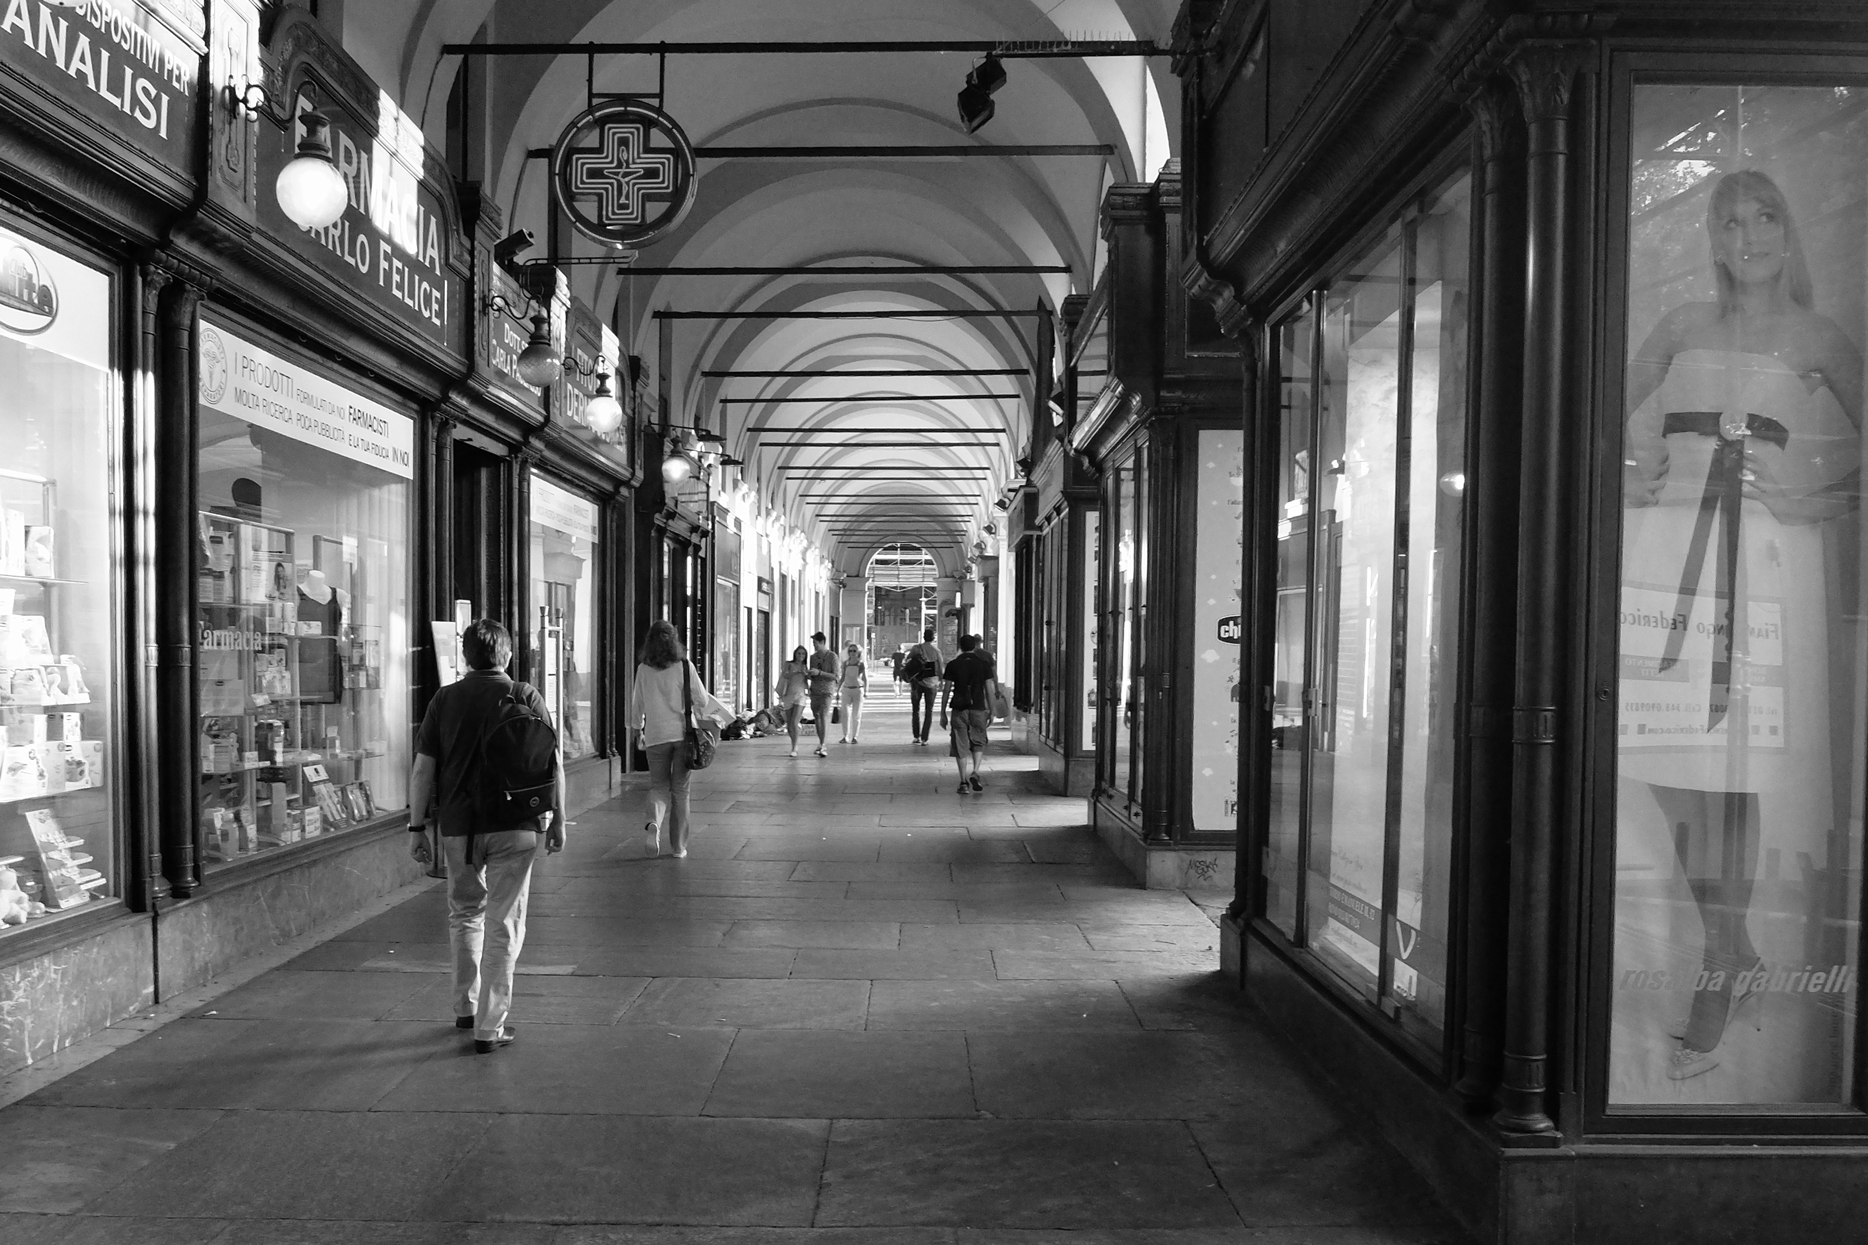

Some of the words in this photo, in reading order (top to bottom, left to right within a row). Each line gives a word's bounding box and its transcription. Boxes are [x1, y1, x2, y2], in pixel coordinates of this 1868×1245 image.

[1, 0, 170, 141] ANALISI
[163, 47, 190, 97] PER
[295, 94, 441, 277] FRMACIA
[298, 216, 371, 275] RLO
[379, 239, 441, 327] FELICE
[234, 386, 260, 411] MOLTA
[262, 398, 294, 425] RICERCA
[296, 412, 312, 432] POCA
[242, 355, 294, 399] PRODOTTI
[348, 404, 390, 438] FARMACISTI
[1618, 966, 1728, 992] rosaba
